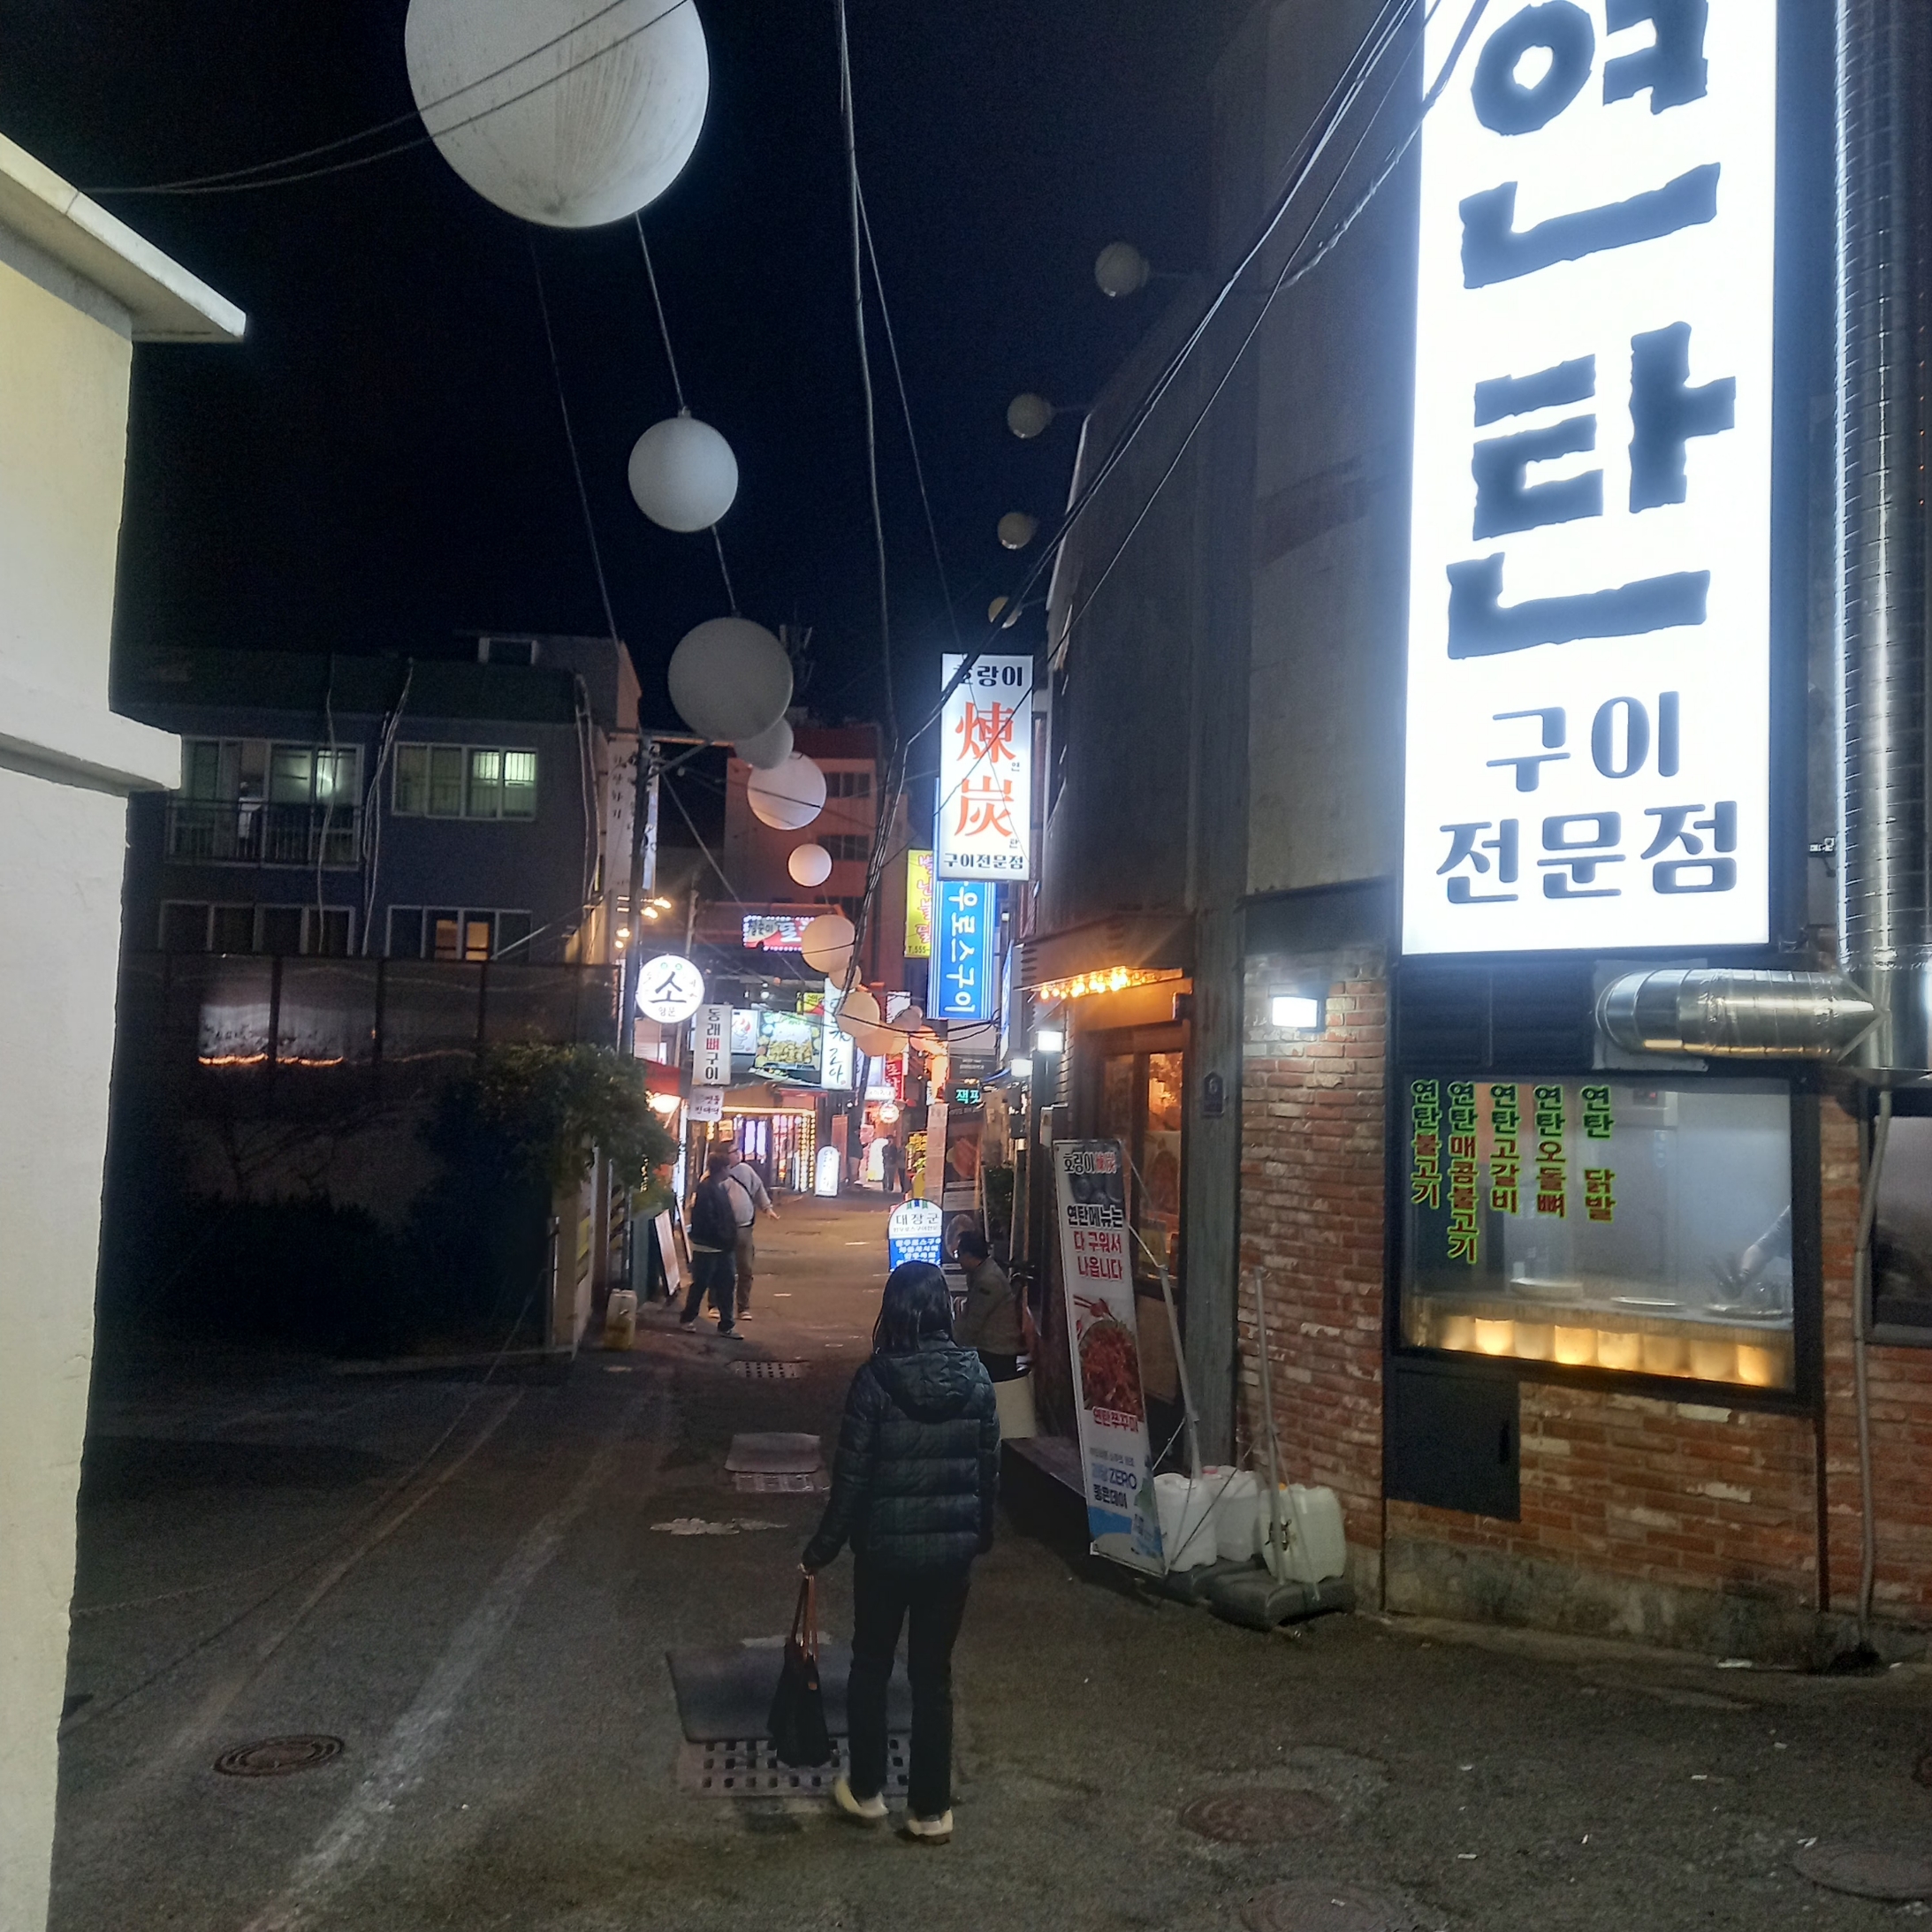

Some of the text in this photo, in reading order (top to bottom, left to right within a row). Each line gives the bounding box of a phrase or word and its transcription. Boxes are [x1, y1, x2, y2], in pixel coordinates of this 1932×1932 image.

[1486, 690, 1680, 793] 구이
[943, 852, 1023, 870] 구이전문점
[1436, 800, 1738, 904] 전문점
[648, 971, 687, 1003] 소
[945, 881, 978, 1013] 우로스구이
[705, 1008, 720, 1080] 동래뼈구이
[1062, 1152, 1095, 1174] 호랑이
[1411, 1079, 1441, 1210] 연탄불고기
[1447, 1081, 1479, 1265] 연탄매콤불고기
[1490, 1083, 1521, 1214] 연탄고갈비
[1533, 1084, 1566, 1219] 연탄오돌뼈
[1580, 1084, 1616, 1223] 연탄 닭발
[896, 1213, 939, 1225] 대장군
[1067, 1205, 1123, 1228] 연탄메뉴는
[1074, 1231, 1122, 1253] 다 구워서
[1077, 1257, 1122, 1280] 나옵니다
